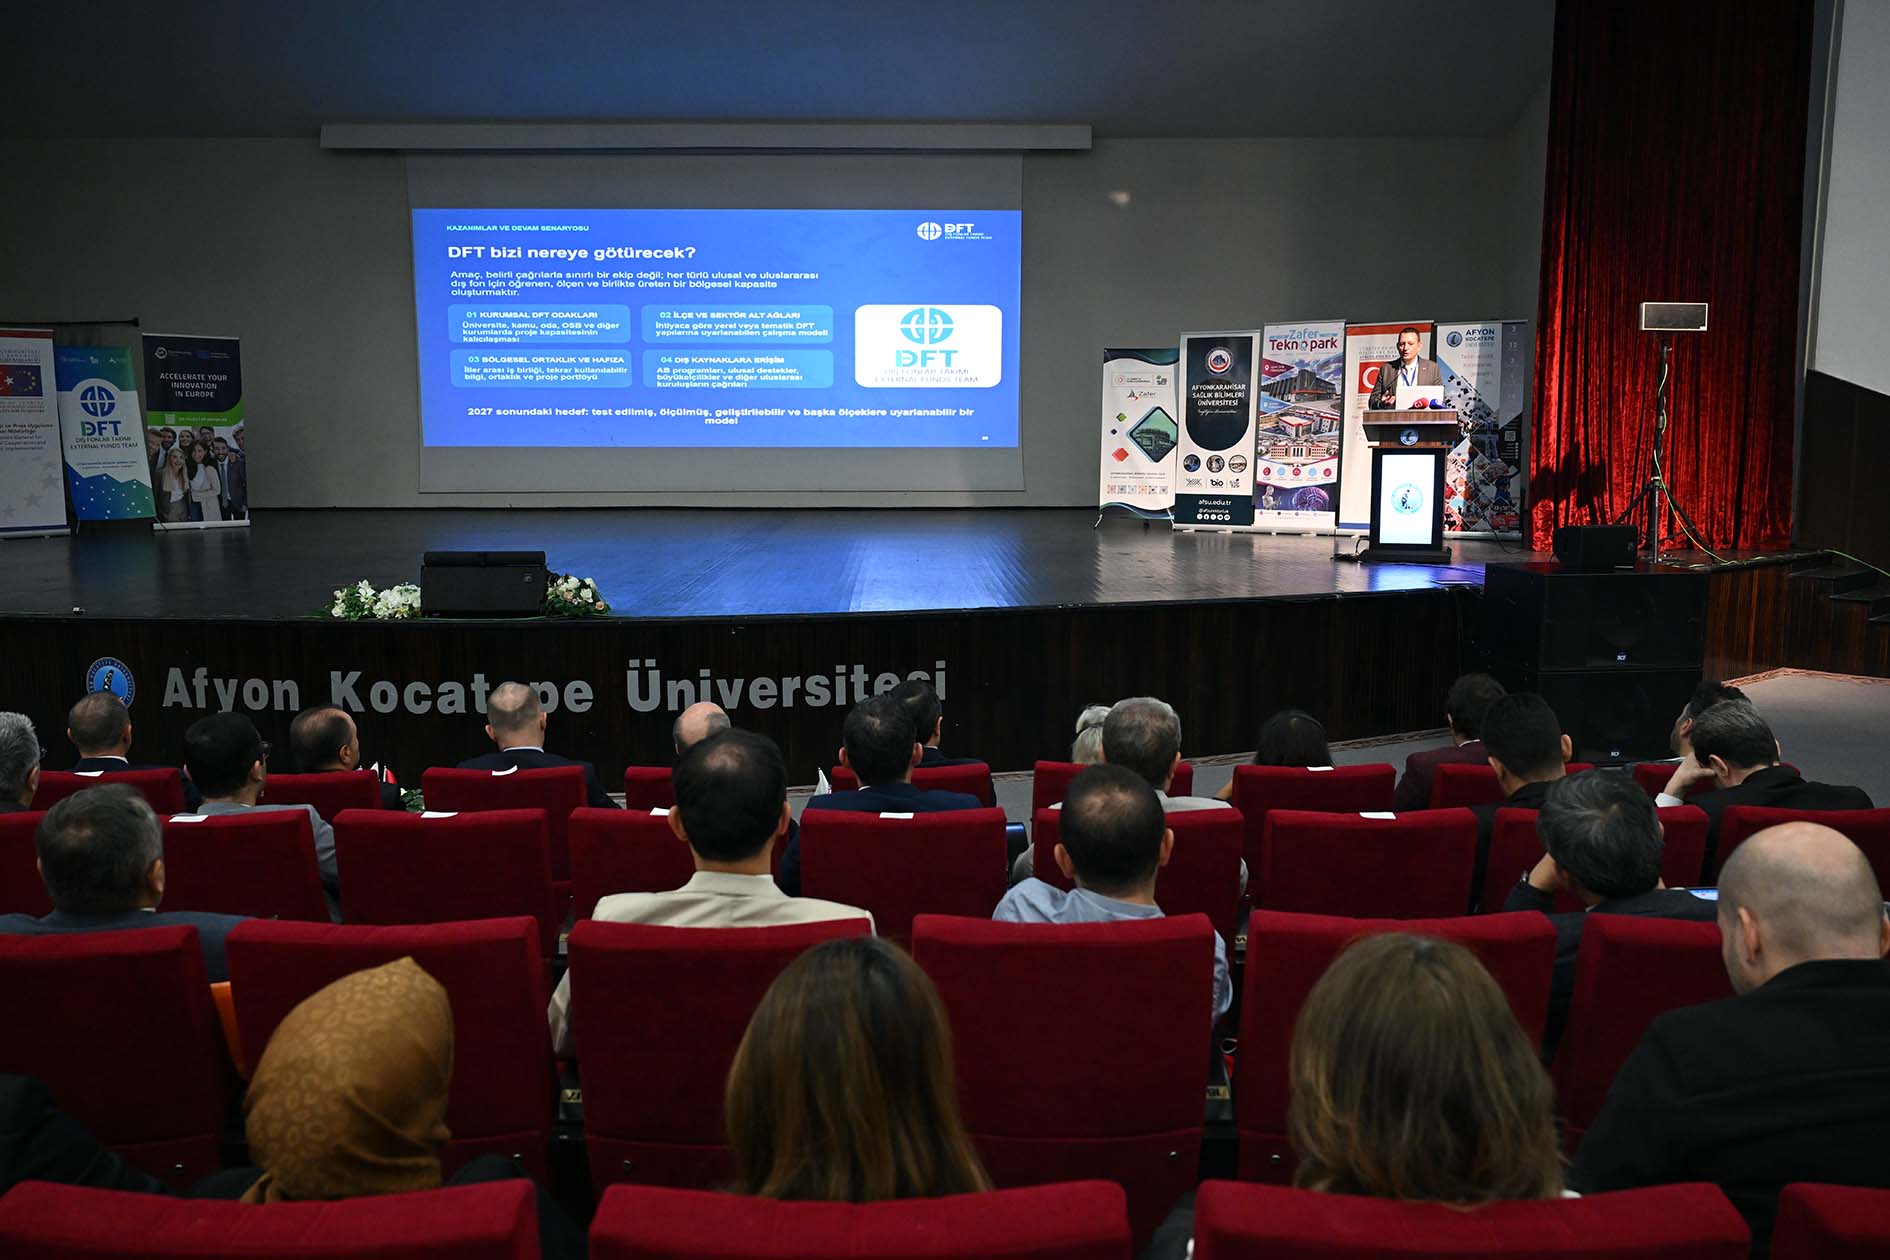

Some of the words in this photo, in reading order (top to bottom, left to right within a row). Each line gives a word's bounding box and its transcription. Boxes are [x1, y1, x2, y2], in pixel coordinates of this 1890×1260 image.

[944, 223, 975, 233] DFT
[447, 246, 486, 258] DFT
[490, 246, 522, 258] bizi
[527, 249, 589, 261] nereye
[593, 246, 697, 261] götürecek?
[450, 271, 483, 280] Amaç,
[485, 271, 513, 279] belirli
[515, 271, 563, 280] çağrılarla
[565, 271, 594, 279] sınırlı
[596, 271, 610, 279] bir
[612, 271, 634, 280] ekip
[636, 271, 664, 280] değil;
[666, 271, 684, 279] her
[686, 271, 709, 279] türlü
[711, 271, 742, 279] ulusal
[759, 271, 819, 279] uluslararası
[450, 280, 467, 289] dış
[469, 280, 486, 288] fon
[488, 280, 506, 289] için
[508, 280, 554, 289] öğrenen,
[556, 280, 584, 289] ölçen
[601, 280, 635, 288] birlikte
[637, 280, 670, 288] üreten
[673, 280, 686, 288] bir
[688, 280, 732, 289] bölgesel
[734, 280, 778, 289] kapasite
[450, 288, 520, 297] oluşturmaktır.
[1289, 328, 1320, 340] Zafer
[1465, 328, 1496, 336] AFYON
[896, 350, 959, 367] DFT
[160, 372, 207, 381] ACCELERATE
[207, 374, 228, 382] YOUR
[171, 382, 218, 390] INNOVATION
[175, 390, 184, 398] IN
[185, 390, 215, 398] EUROPE
[467, 408, 493, 416] 2027
[495, 408, 552, 416] sonundaki
[555, 408, 589, 416] hedef:
[591, 408, 613, 416] test
[615, 408, 657, 416] edilmiş,
[659, 408, 713, 416] ölçülmüş,
[714, 408, 786, 416] geliştirilebilir
[787, 408, 801, 416] ve
[803, 408, 836, 416] başka
[838, 408, 888, 416] ölçeklere
[889, 408, 957, 416] uyarlanabilir
[959, 408, 975, 416] bir
[704, 417, 739, 425] model
[81, 420, 122, 437] DFT
[162, 666, 300, 714] Afyon
[329, 670, 594, 714] Kocatpe
